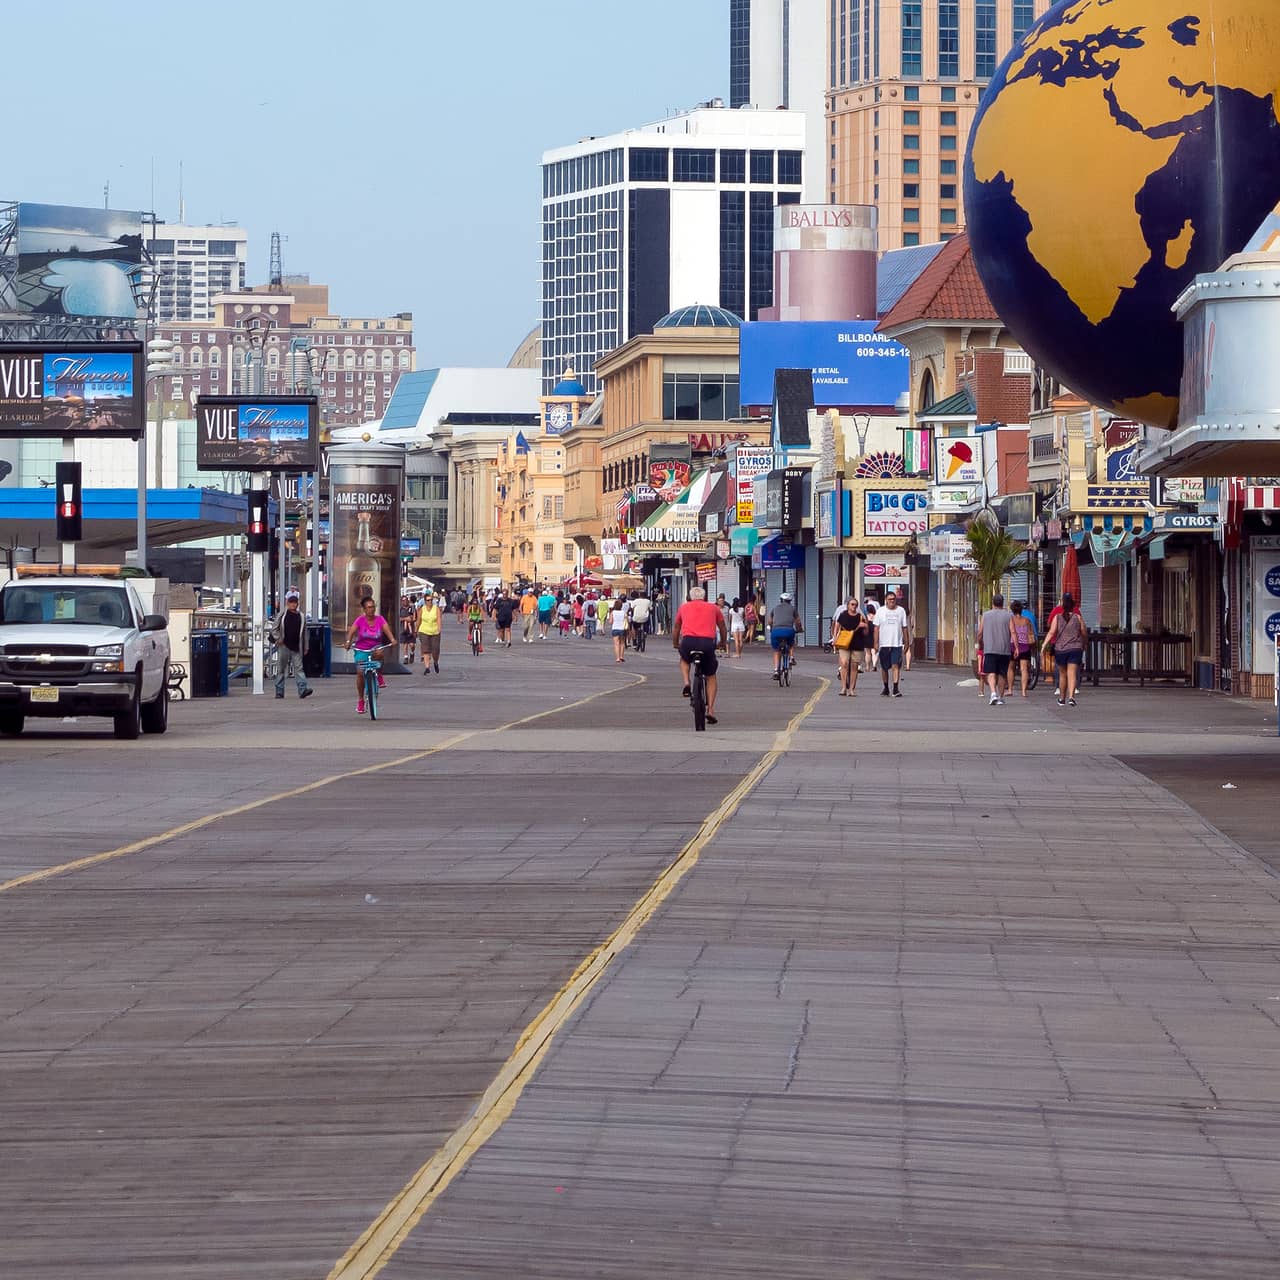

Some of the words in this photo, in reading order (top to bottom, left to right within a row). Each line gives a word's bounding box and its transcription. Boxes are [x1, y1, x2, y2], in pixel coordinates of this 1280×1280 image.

[790, 209, 852, 228] BALLY'S
[46, 357, 130, 381] Flavors
[815, 377, 849, 385] AVAILABLE
[738, 457, 772, 465] GYROS
[336, 492, 393, 506] AMERICA'S
[867, 492, 900, 513] BIG
[867, 520, 927, 532] TATTOOS
[1172, 515, 1211, 526] GYROS
[635, 527, 664, 542] FOOD
